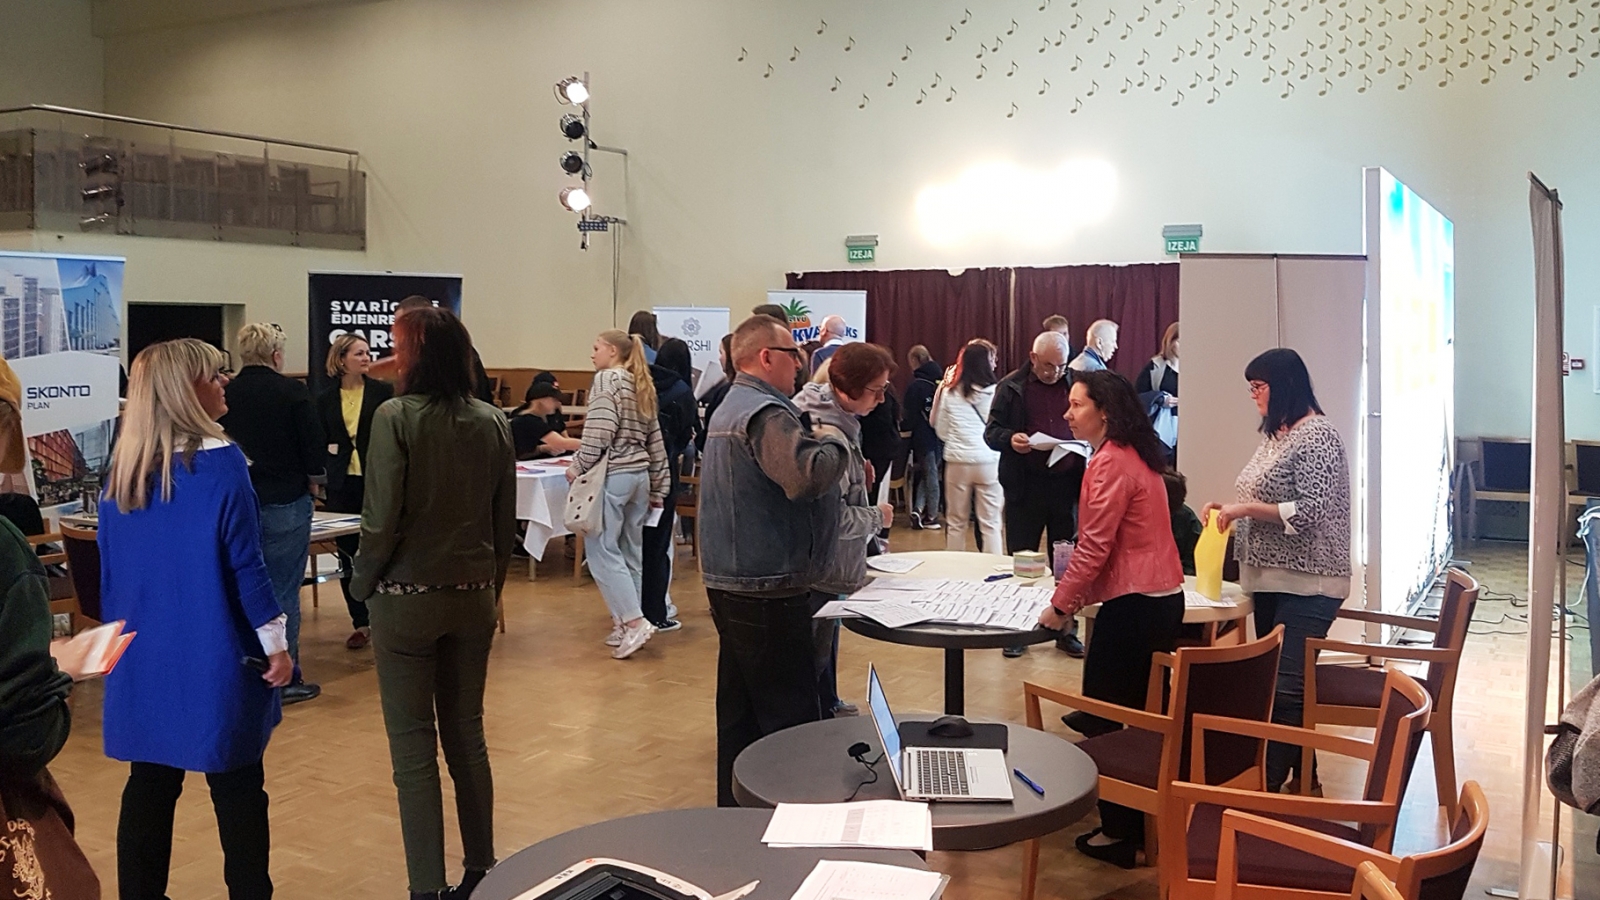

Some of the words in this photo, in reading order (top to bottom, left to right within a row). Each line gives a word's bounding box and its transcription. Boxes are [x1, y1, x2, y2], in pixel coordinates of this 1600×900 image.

[1168, 241, 1196, 251] IZEJA
[850, 250, 873, 259] IZEJA
[331, 312, 396, 325] ĒDIENRE
[687, 340, 711, 351] RSHI
[27, 385, 91, 399] SKONTO
[27, 402, 50, 410] PLAN
